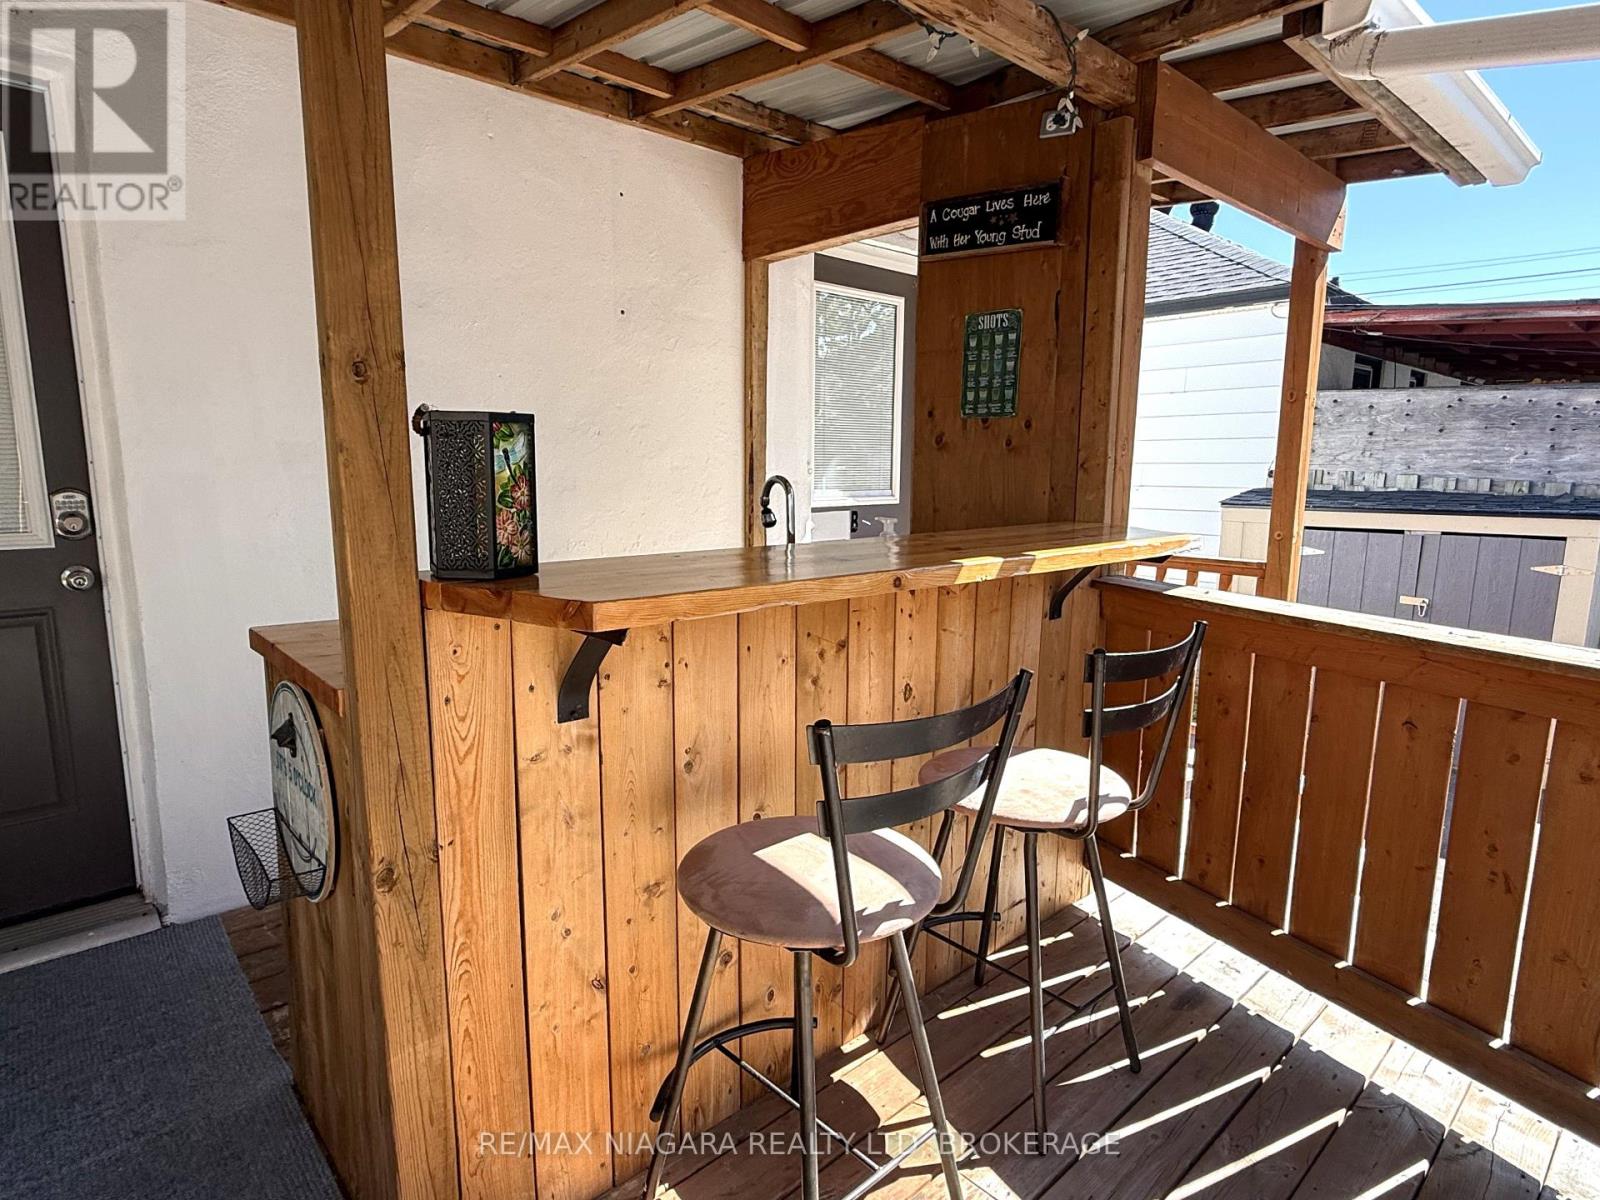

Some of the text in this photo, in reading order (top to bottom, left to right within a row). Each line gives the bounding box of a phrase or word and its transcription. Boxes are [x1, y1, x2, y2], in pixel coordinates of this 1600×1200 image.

[929, 192, 1051, 223] A Cougar Lives Here
[929, 221, 1042, 250] With Her Young Stud
[978, 313, 1009, 330] SHOTS
